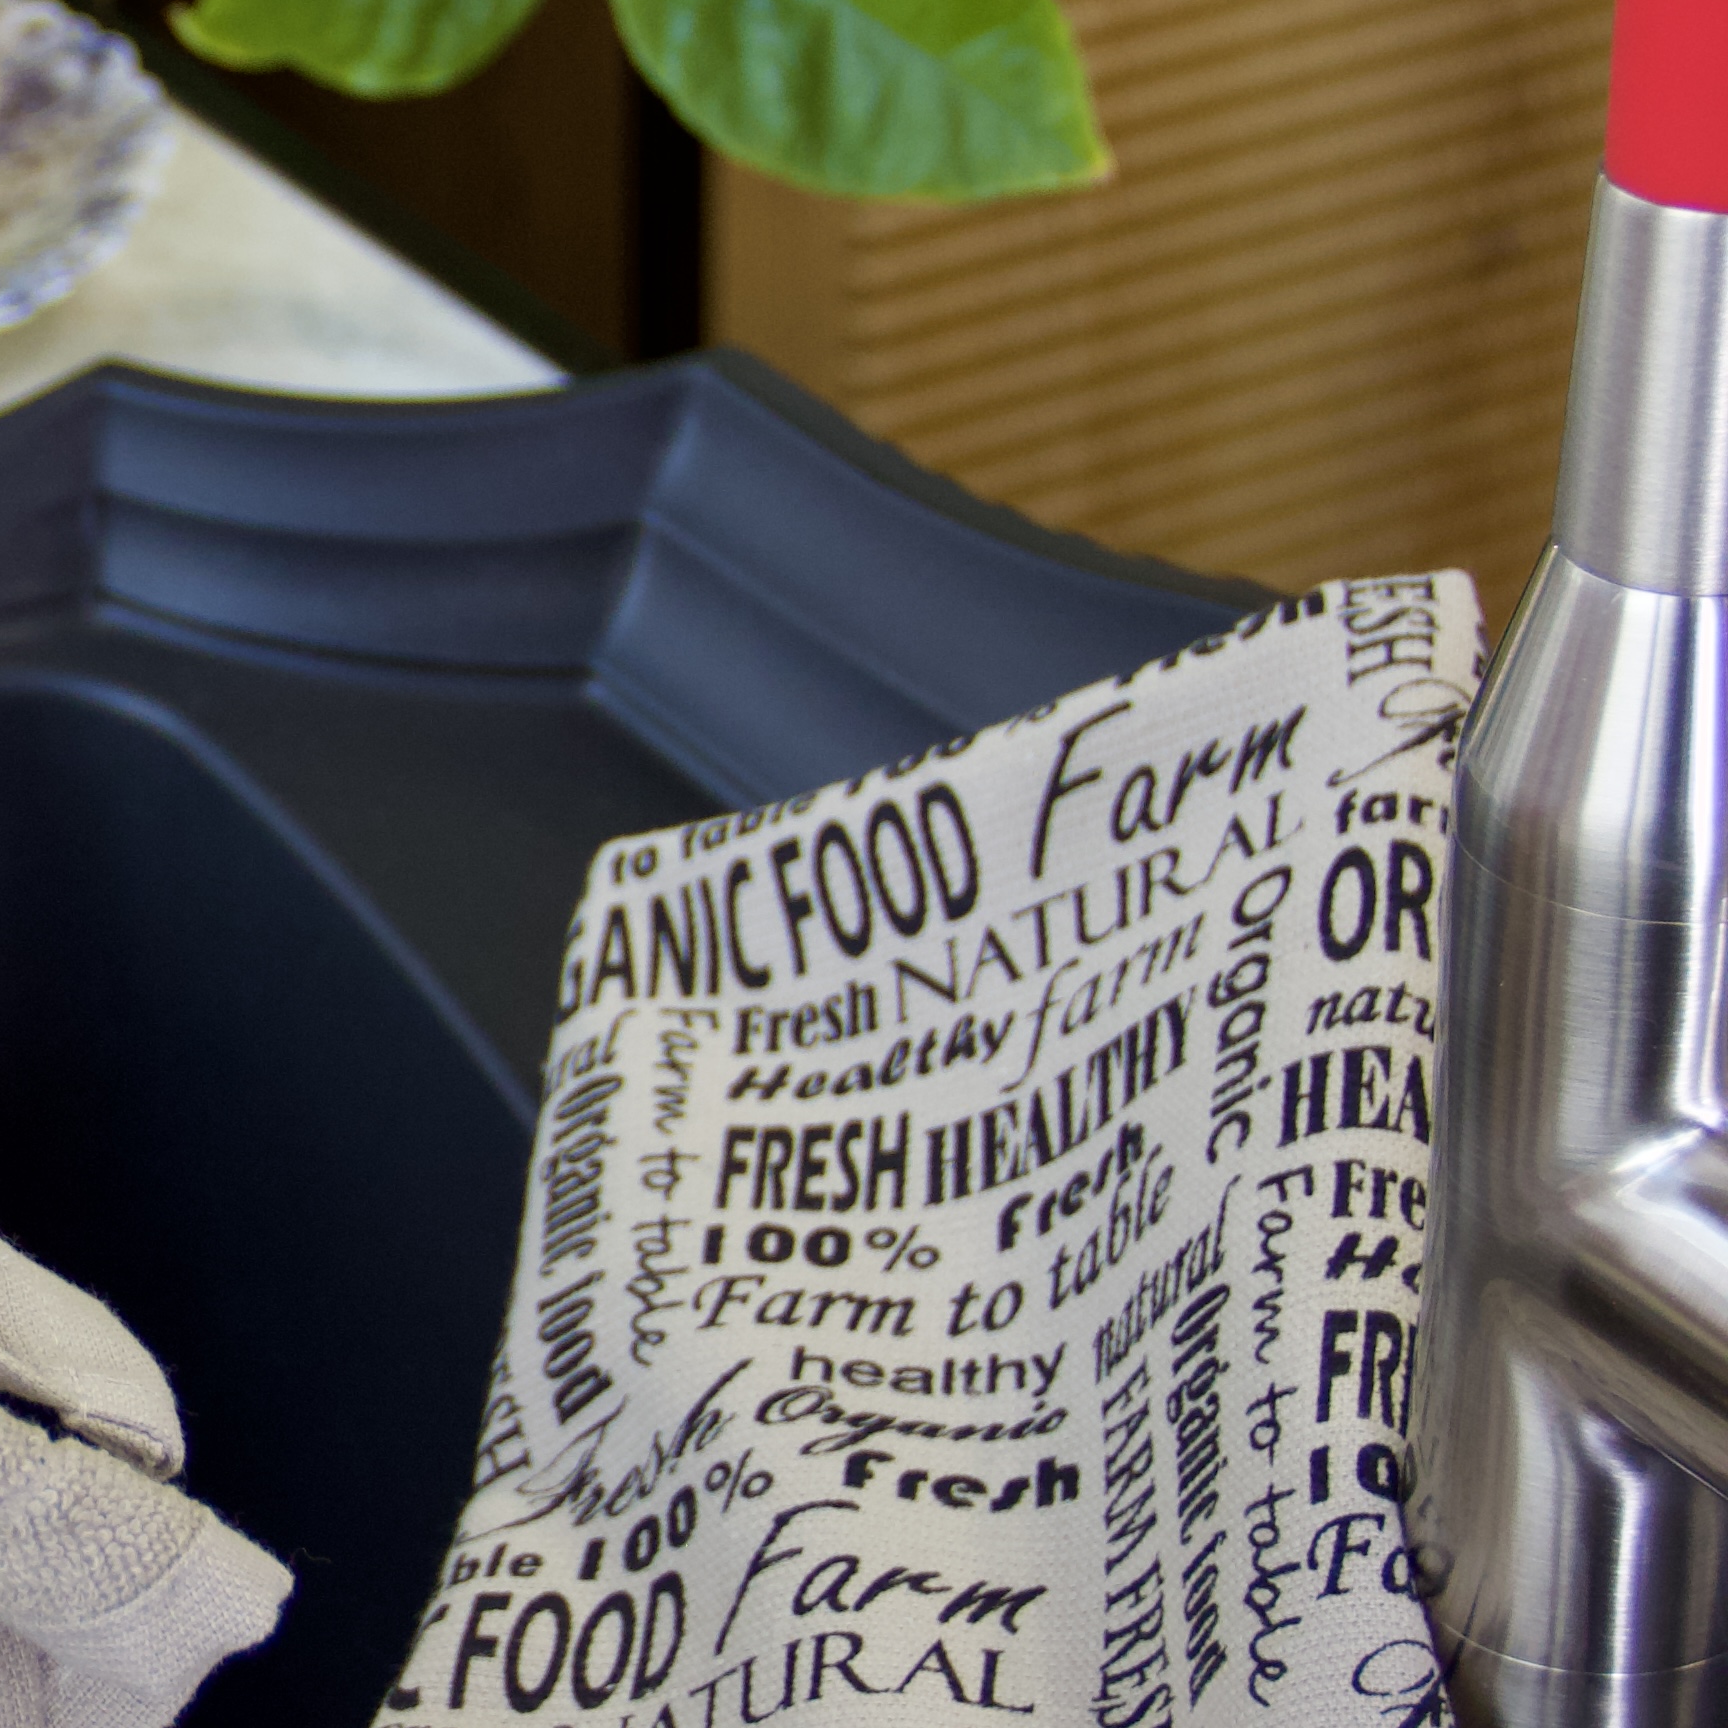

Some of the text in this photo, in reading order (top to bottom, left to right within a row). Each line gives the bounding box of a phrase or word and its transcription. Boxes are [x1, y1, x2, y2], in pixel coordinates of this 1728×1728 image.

[1029, 697, 1307, 880] Farm
[768, 781, 979, 978] FOOD
[890, 790, 1306, 1024] NATURAL
[652, 1006, 720, 1135] Farm
[727, 1009, 1014, 1102] Healthy
[734, 980, 879, 1062] Fresh
[999, 908, 1206, 1095] farm
[713, 1109, 911, 1213] FRESH
[924, 983, 1198, 1208] HEALTHY
[638, 1145, 702, 1202] to
[692, 1143, 1174, 1339] Farm to table
[700, 1222, 942, 1273] 100%
[753, 1384, 1070, 1458] Organic
[790, 1340, 1068, 1398] healthy
[1243, 1163, 1314, 1708] Farm to table
[577, 1448, 774, 1582] 100%
[1102, 1354, 1159, 1575] FARM
[447, 1569, 688, 1714] FOOD
[714, 1498, 1048, 1657] Farm
